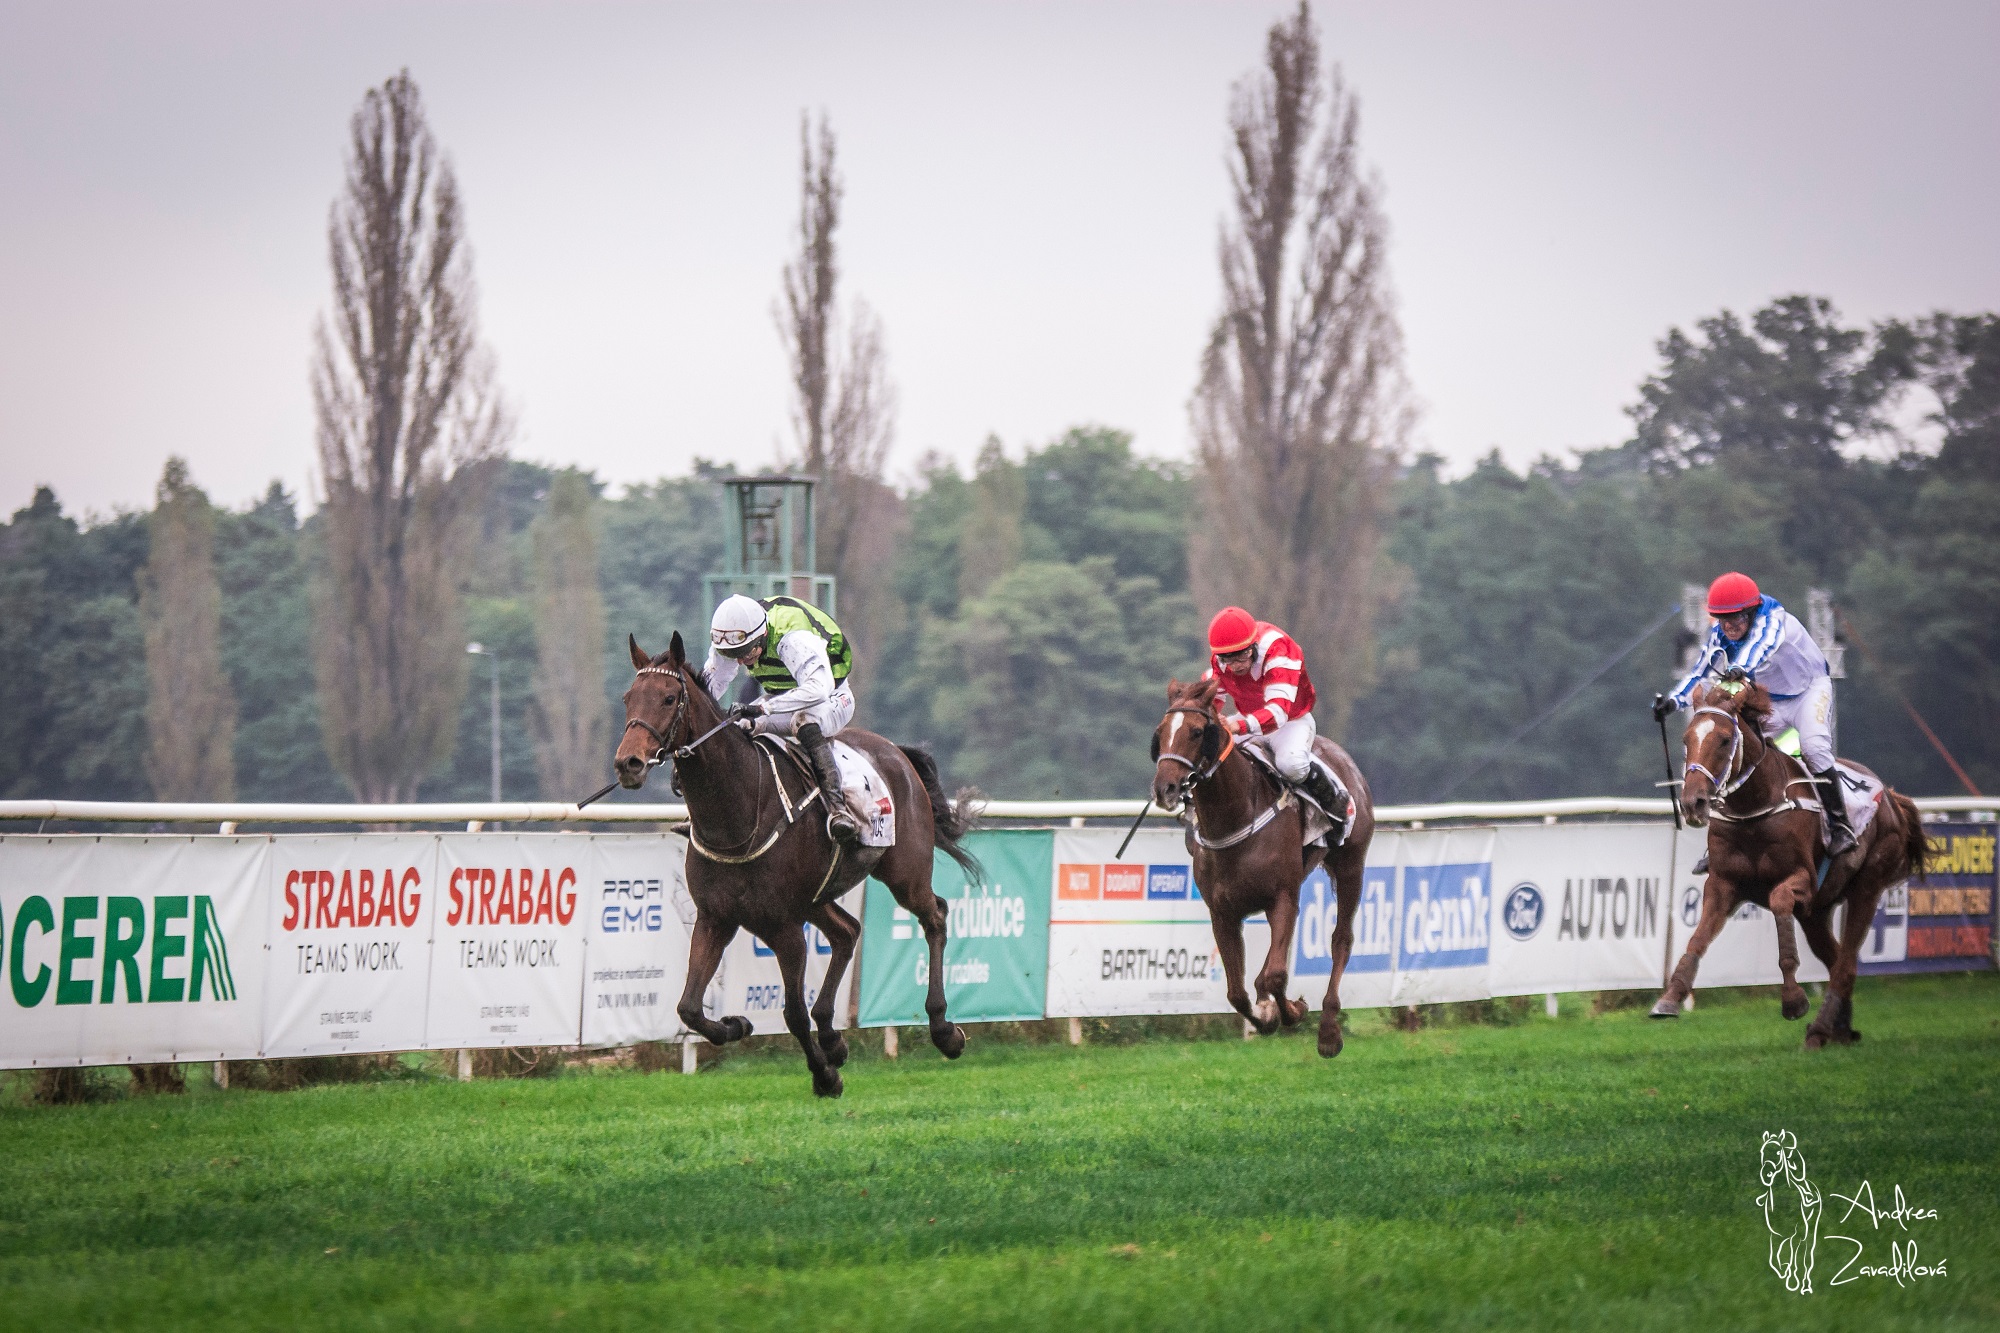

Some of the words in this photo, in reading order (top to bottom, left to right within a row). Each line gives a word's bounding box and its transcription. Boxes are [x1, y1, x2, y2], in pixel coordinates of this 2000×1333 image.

[282, 866, 421, 932] STRABAG
[446, 866, 577, 927] STRABAG
[603, 879, 663, 900] PROFI
[601, 905, 662, 933] EMG
[1557, 877, 1630, 941] AUTO
[1634, 877, 1660, 939] IN
[297, 943, 349, 974] TEAMS
[354, 941, 404, 971] WORK.
[460, 939, 507, 968] TEAMS
[513, 939, 560, 968] WORK.
[1101, 948, 1208, 980] BARTH-GO.cz
